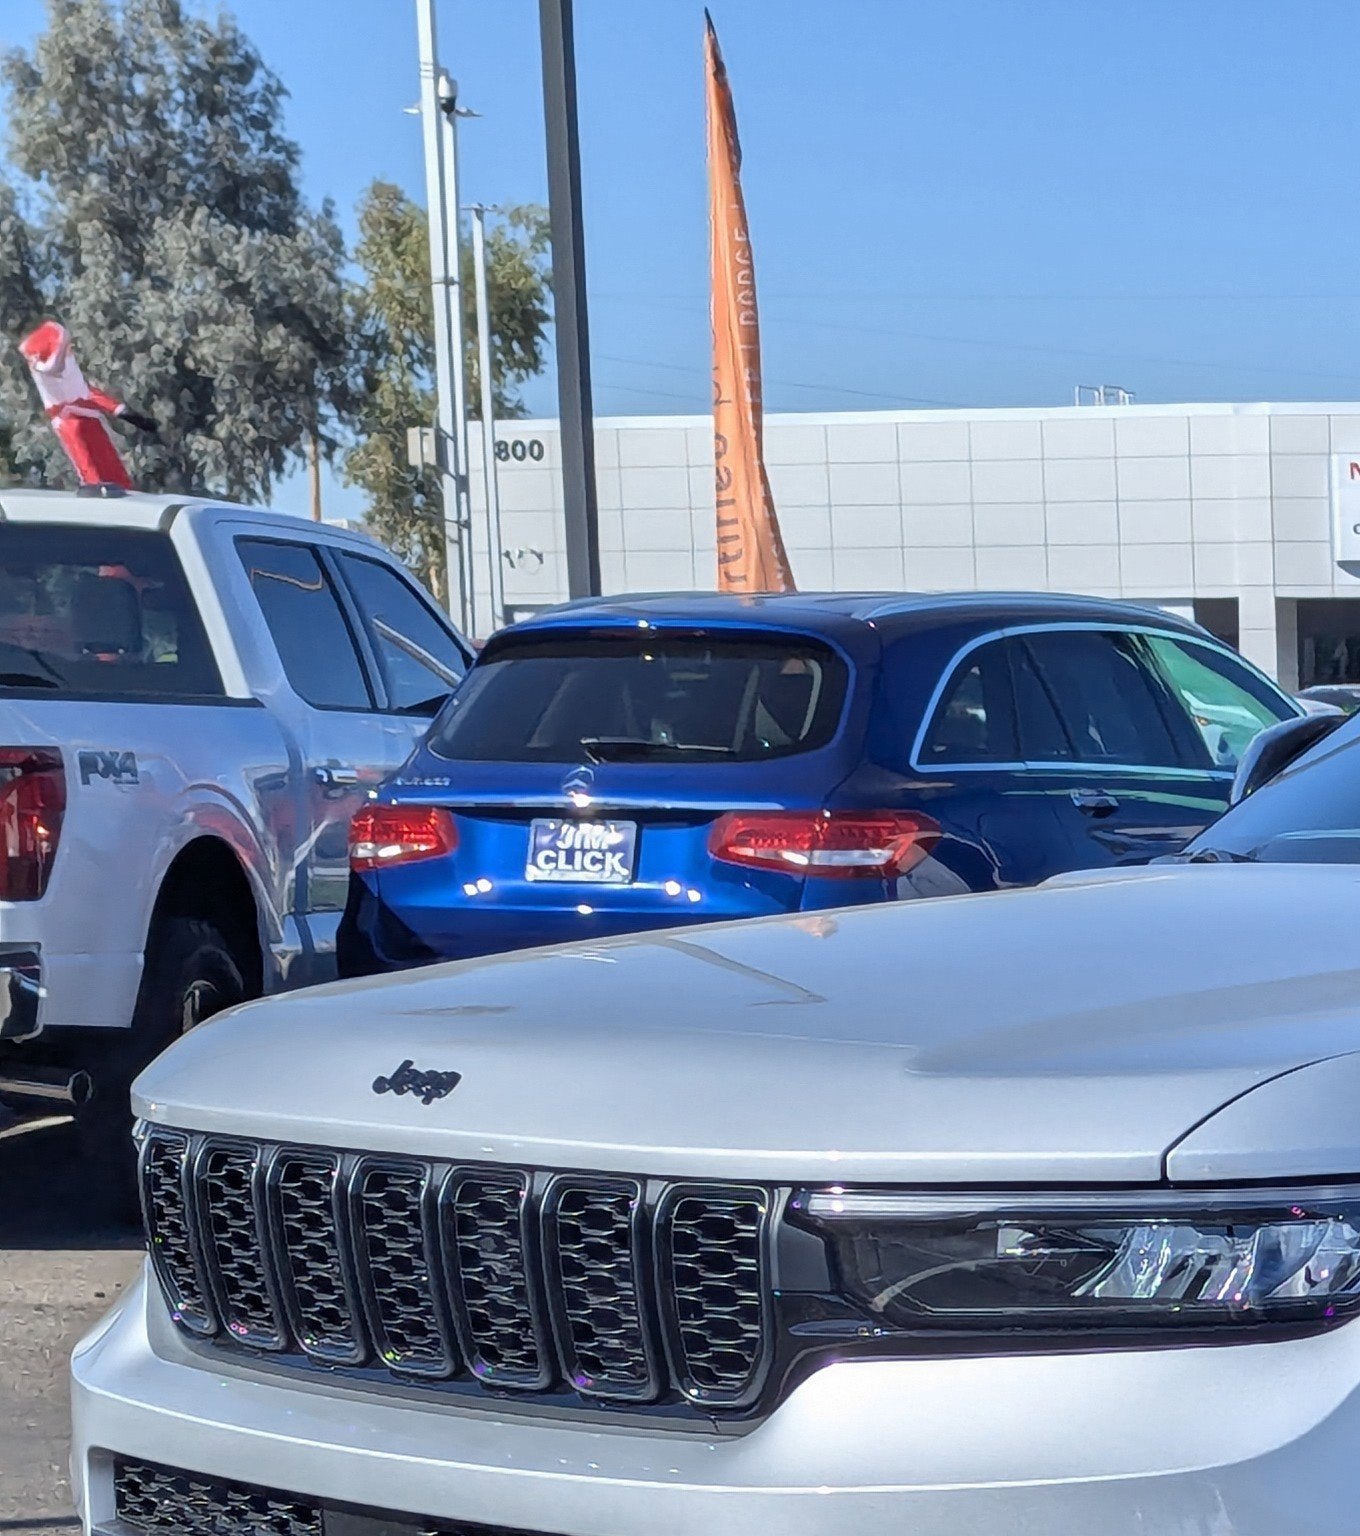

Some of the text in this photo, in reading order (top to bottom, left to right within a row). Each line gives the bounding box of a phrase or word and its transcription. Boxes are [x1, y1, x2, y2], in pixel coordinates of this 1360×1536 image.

[494, 439, 545, 462] 800
[78, 750, 139, 786] FX4
[556, 822, 611, 849] JIM
[536, 849, 629, 877] CLICK
[372, 1059, 462, 1105] Jeep
